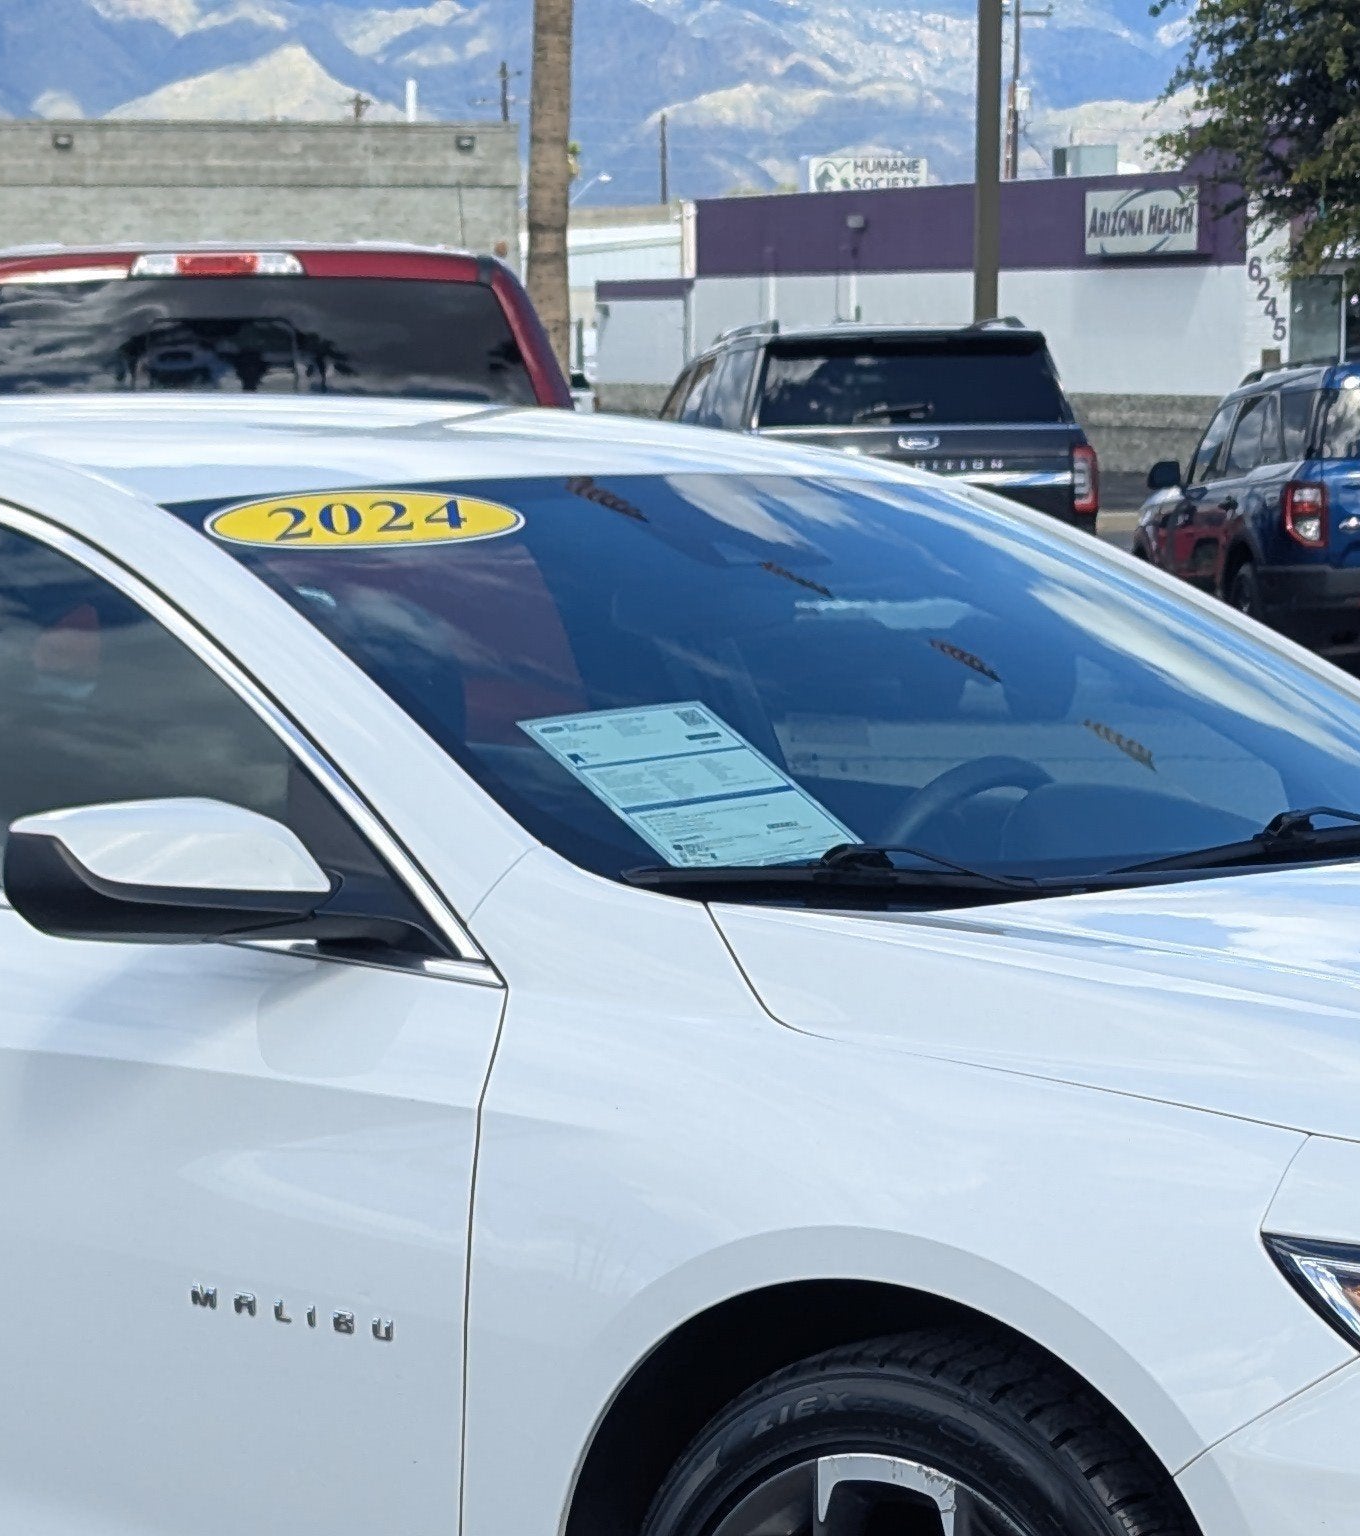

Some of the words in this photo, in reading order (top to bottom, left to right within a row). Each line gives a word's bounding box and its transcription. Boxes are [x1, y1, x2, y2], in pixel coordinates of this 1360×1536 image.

[853, 160, 921, 173] HUMANE
[1089, 207, 1144, 238] ARIZONA
[1147, 204, 1196, 236] HEALTH
[267, 499, 468, 542] 2024
[190, 1280, 394, 1341] MALIBU
